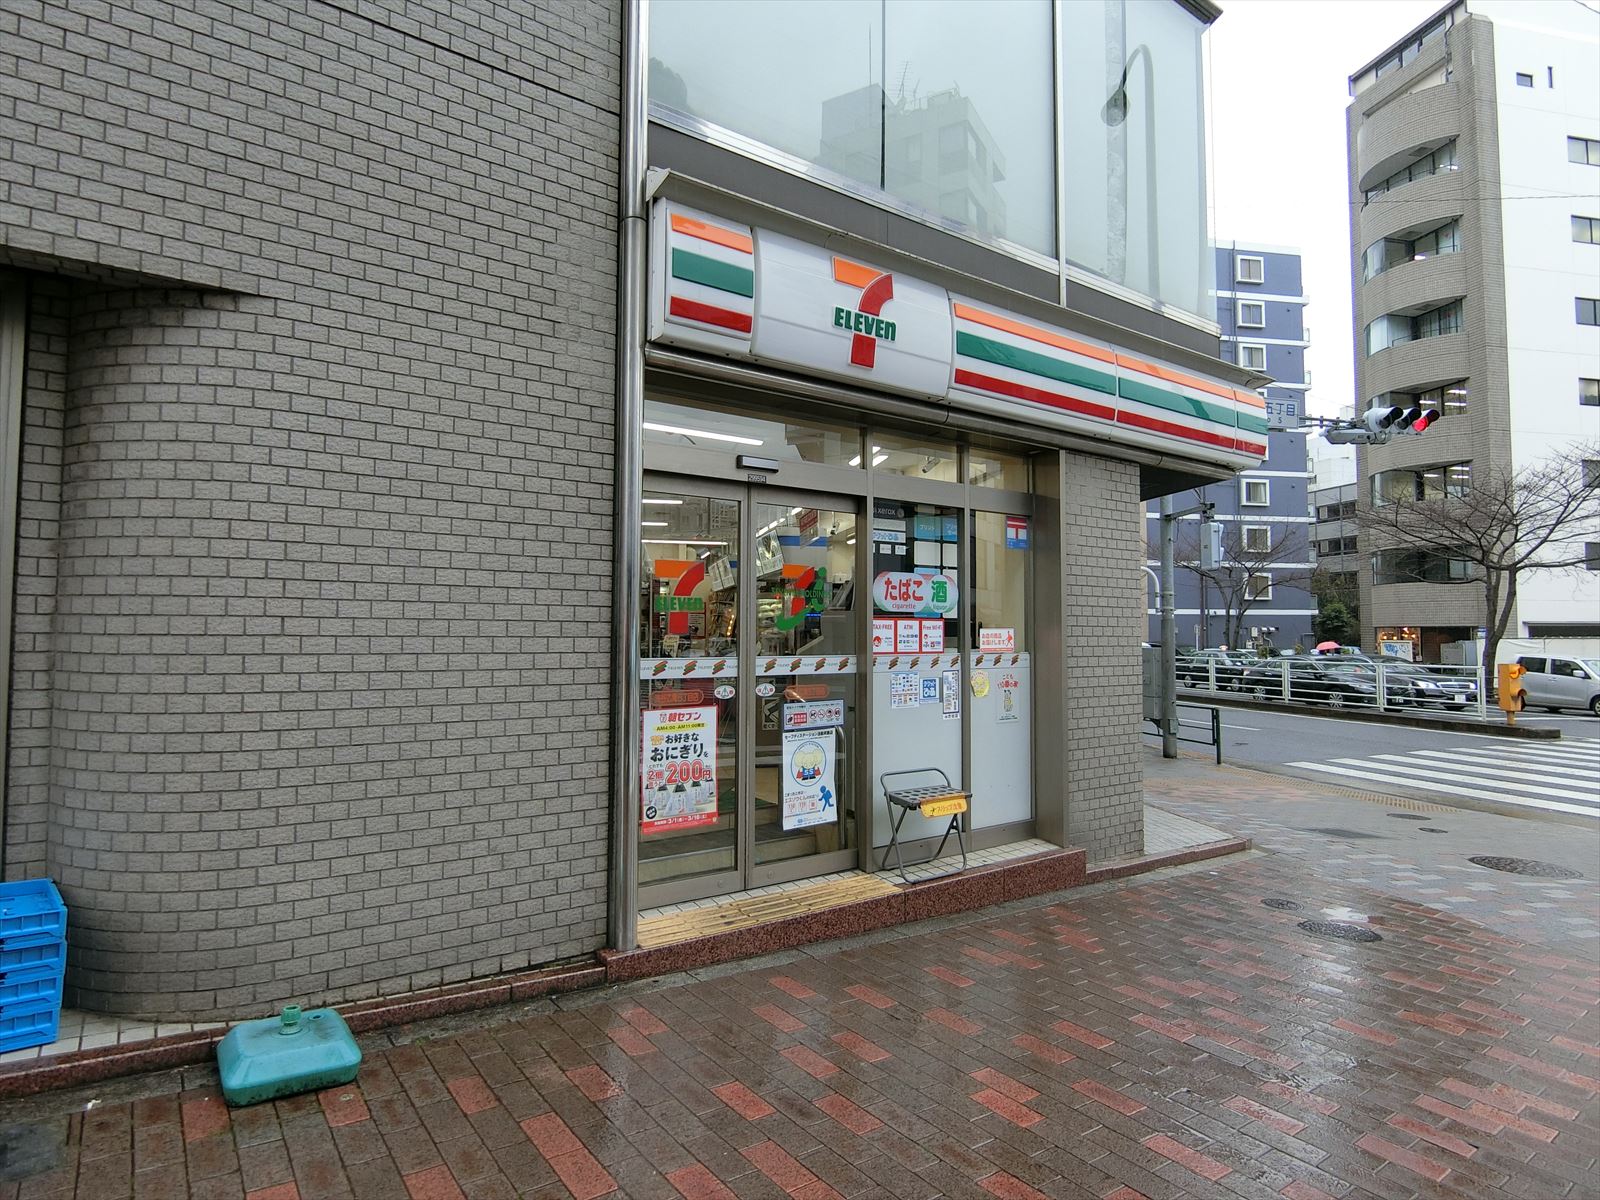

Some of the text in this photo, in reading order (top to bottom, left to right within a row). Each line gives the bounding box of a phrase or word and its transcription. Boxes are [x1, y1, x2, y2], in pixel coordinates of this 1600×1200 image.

[884, 578, 948, 603] たばこ 酒
[665, 733, 700, 744] お好きな
